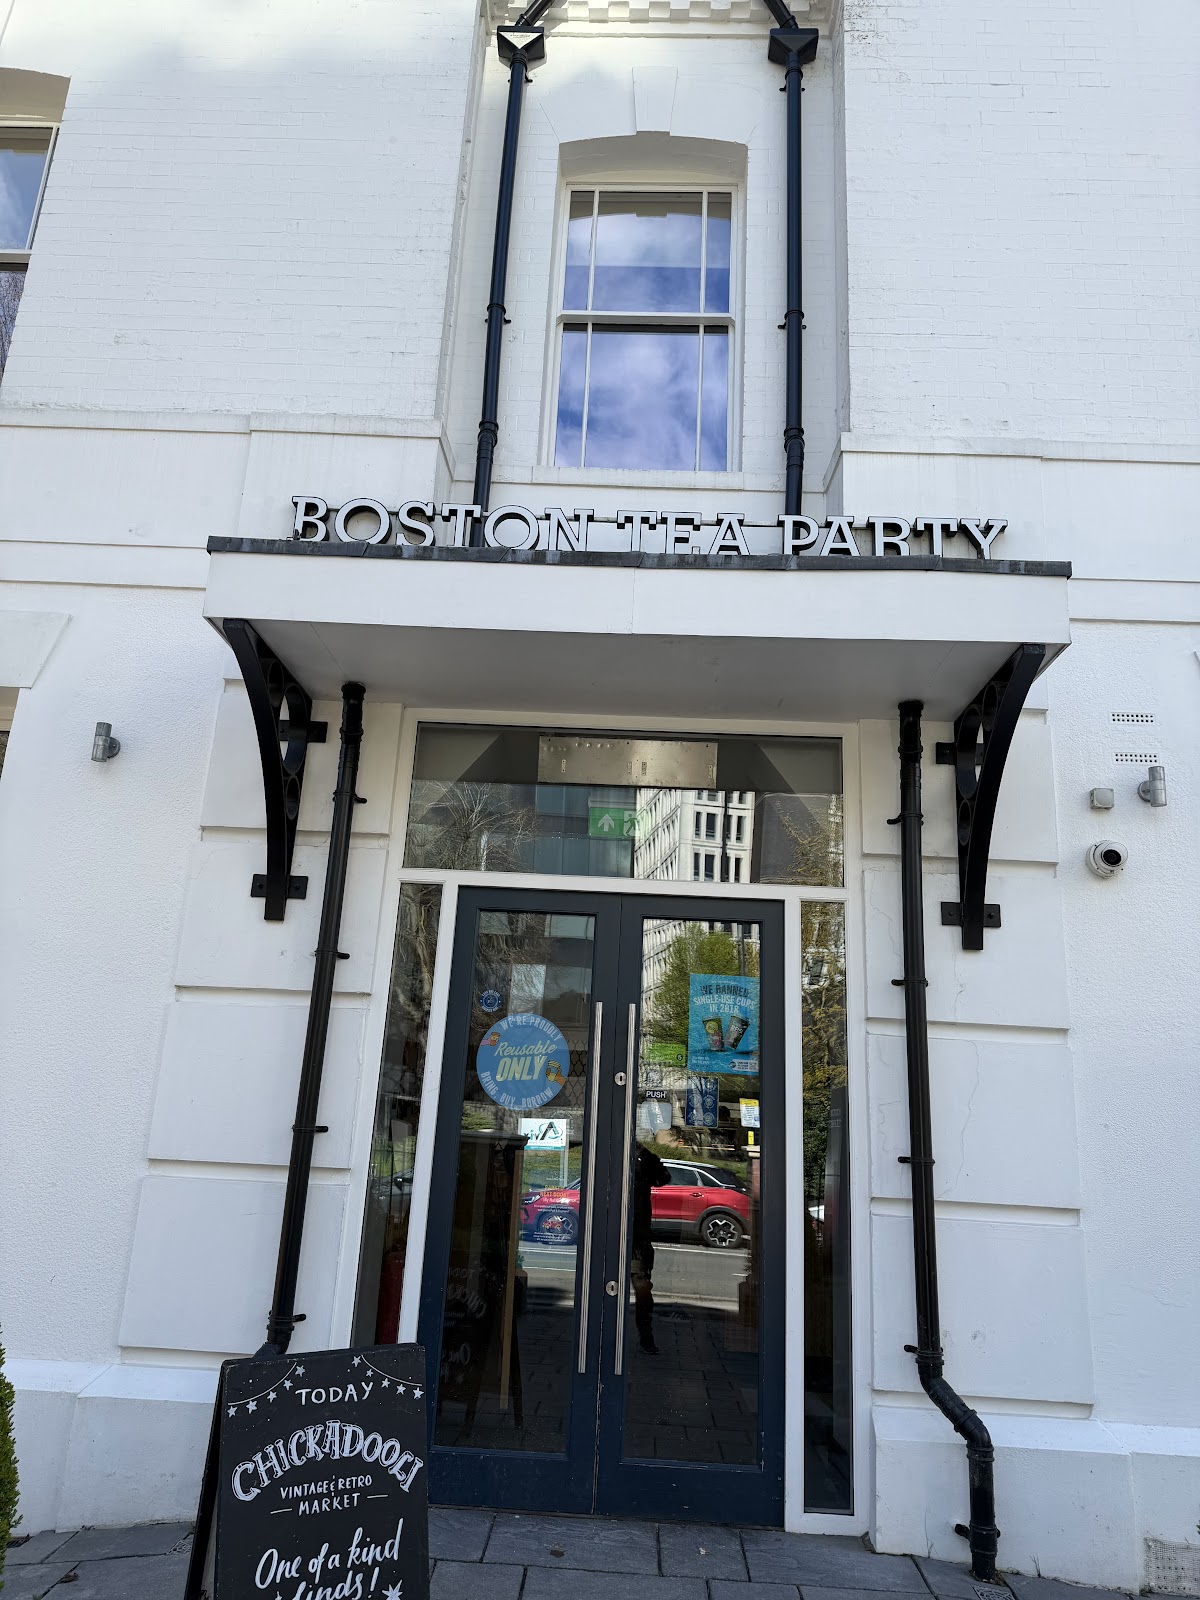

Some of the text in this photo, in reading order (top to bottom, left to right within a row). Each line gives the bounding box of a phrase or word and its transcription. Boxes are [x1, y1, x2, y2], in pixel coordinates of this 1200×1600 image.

[291, 495, 1008, 559] BOSTON TEA PARTY
[693, 994, 756, 1009] SINGLE-USE CUPS
[716, 984, 750, 997] BANNED
[709, 1004, 739, 1013] IN 2018
[500, 1015, 562, 1042] WE'RE PROUDLY
[494, 1040, 557, 1057] Reusable
[496, 1055, 547, 1082] ONLY
[521, 1087, 553, 1108] BORROW
[646, 1090, 666, 1099] PUSH
[295, 1381, 373, 1405] TODAY
[280, 1481, 329, 1499] VINTAGE
[338, 1474, 373, 1490] RETRO
[298, 1492, 361, 1516] MARKET
[255, 1518, 404, 1589] One of a kind
